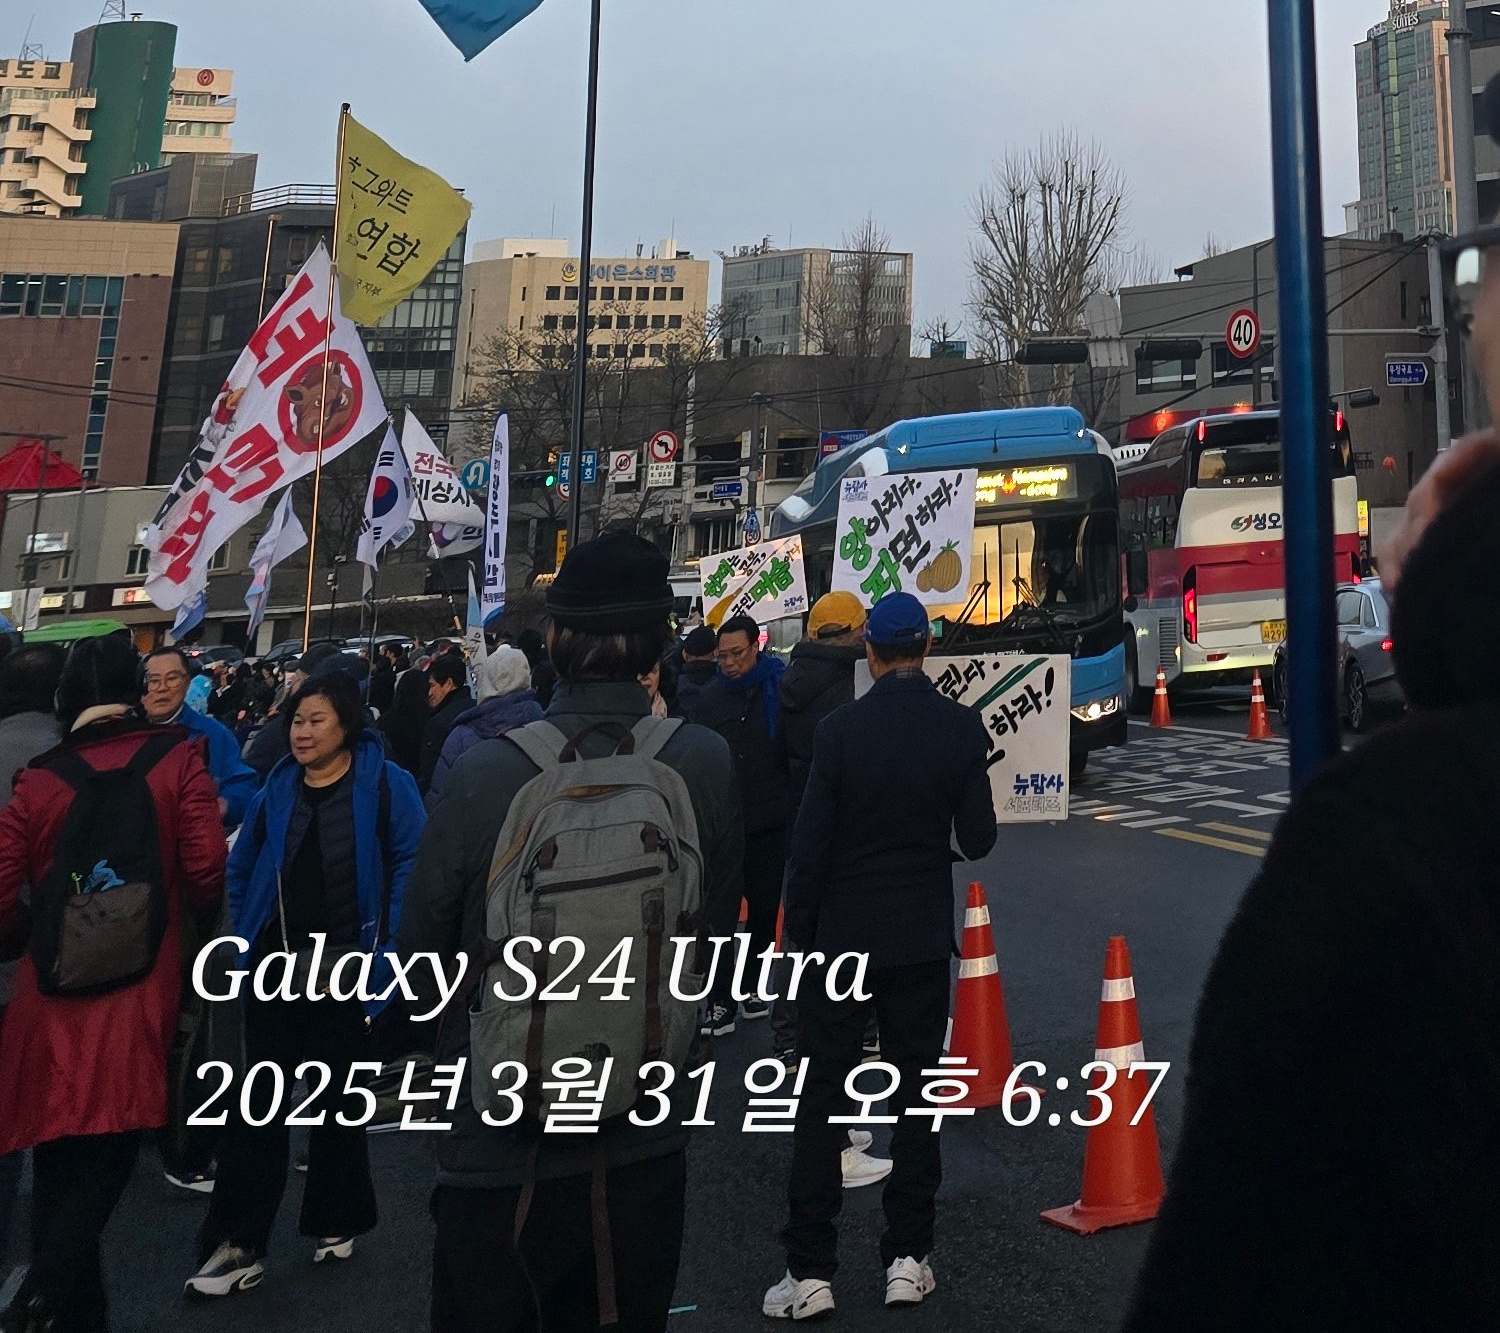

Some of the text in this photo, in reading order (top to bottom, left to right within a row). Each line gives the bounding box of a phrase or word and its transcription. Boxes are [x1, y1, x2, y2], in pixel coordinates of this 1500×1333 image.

[0, 58, 62, 80] 도교
[357, 216, 422, 277] 연합
[1233, 318, 1253, 346] 40
[414, 451, 455, 480] 전국
[839, 475, 922, 571] 양아치다.
[860, 472, 963, 606] 파면하라!
[933, 658, 1001, 703] 린다.
[1013, 773, 1064, 796] 뉴탐사
